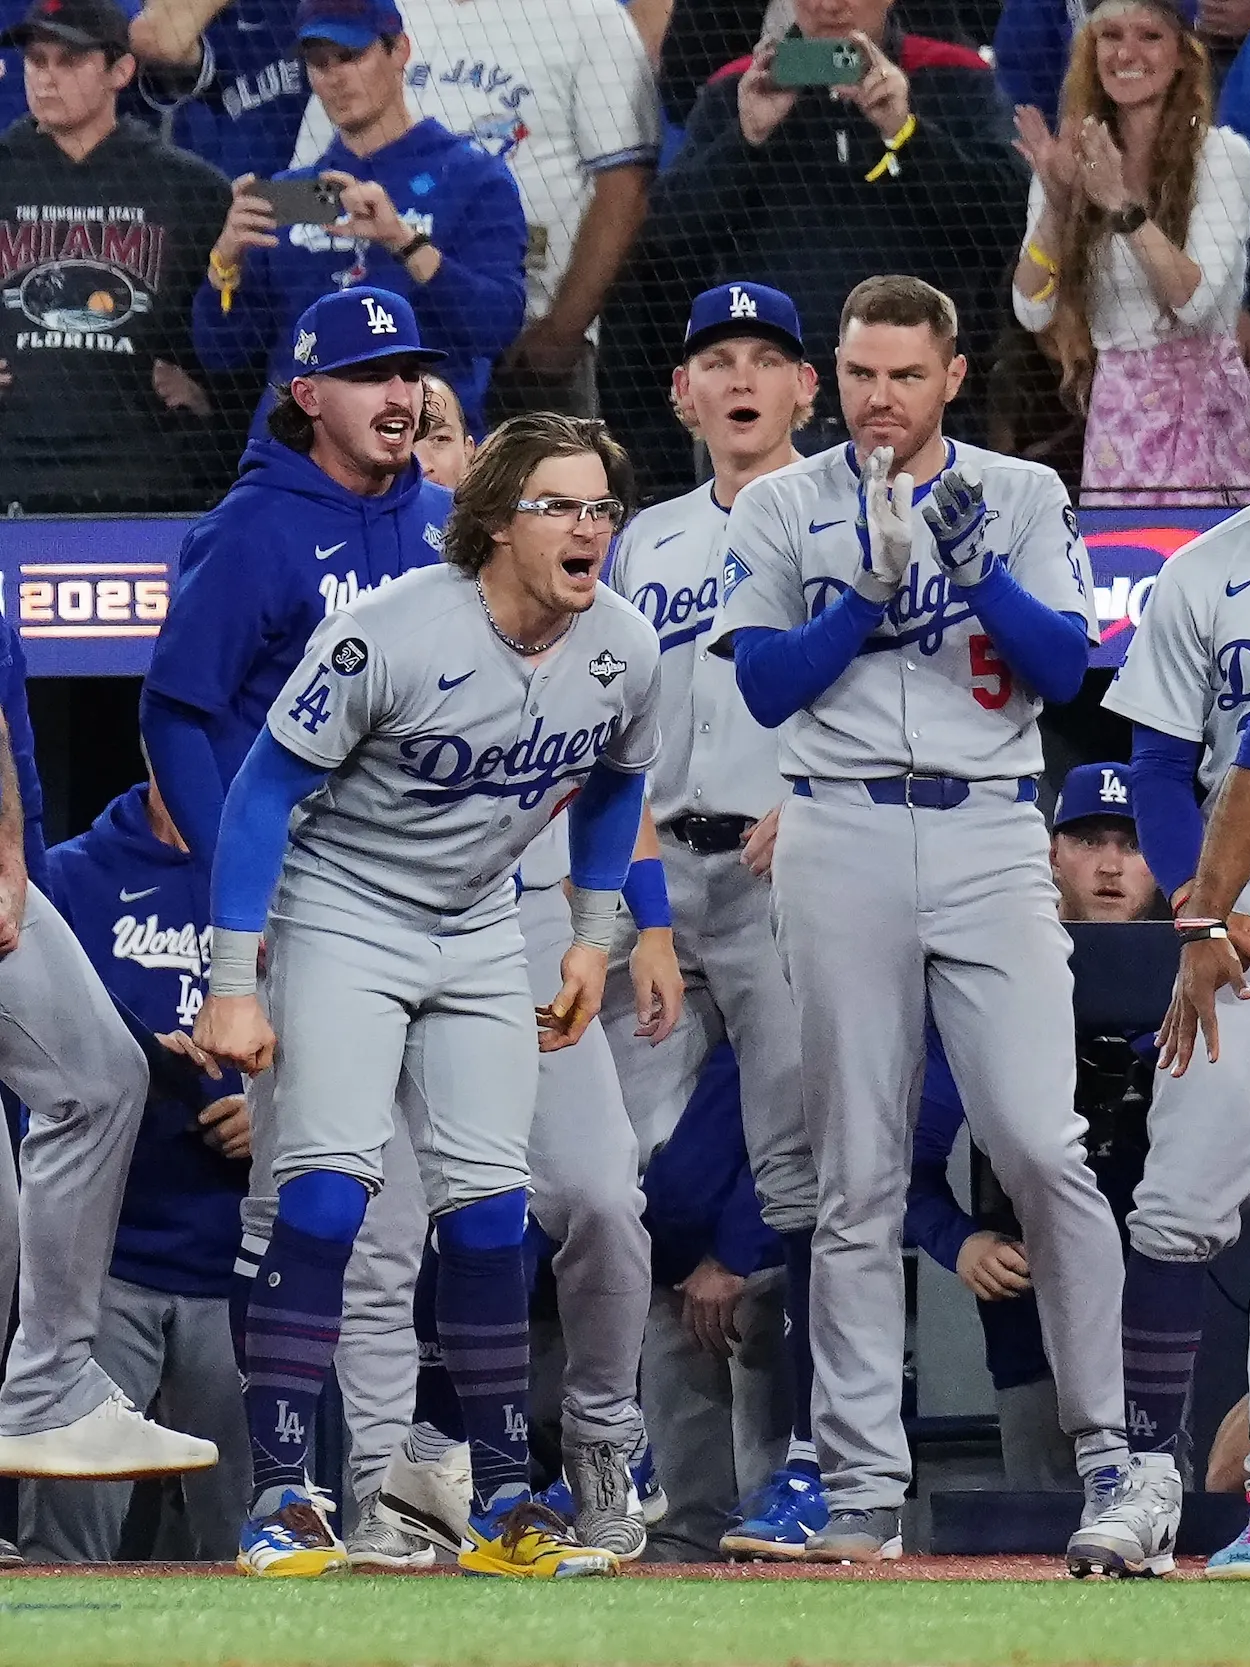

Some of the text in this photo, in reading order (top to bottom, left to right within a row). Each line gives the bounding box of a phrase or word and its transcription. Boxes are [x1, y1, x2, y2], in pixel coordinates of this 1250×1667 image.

[0, 219, 165, 293] MIAMI
[361, 297, 398, 335] LA
[729, 286, 757, 318] LA
[17, 331, 135, 355] FLORIDA
[19, 580, 171, 621] 2025
[969, 633, 1012, 710] 5
[288, 662, 331, 735] LA
[1099, 769, 1128, 804] LA
[274, 1400, 305, 1444] LA
[502, 1404, 528, 1441] LA
[1127, 1400, 1157, 1437] LA
